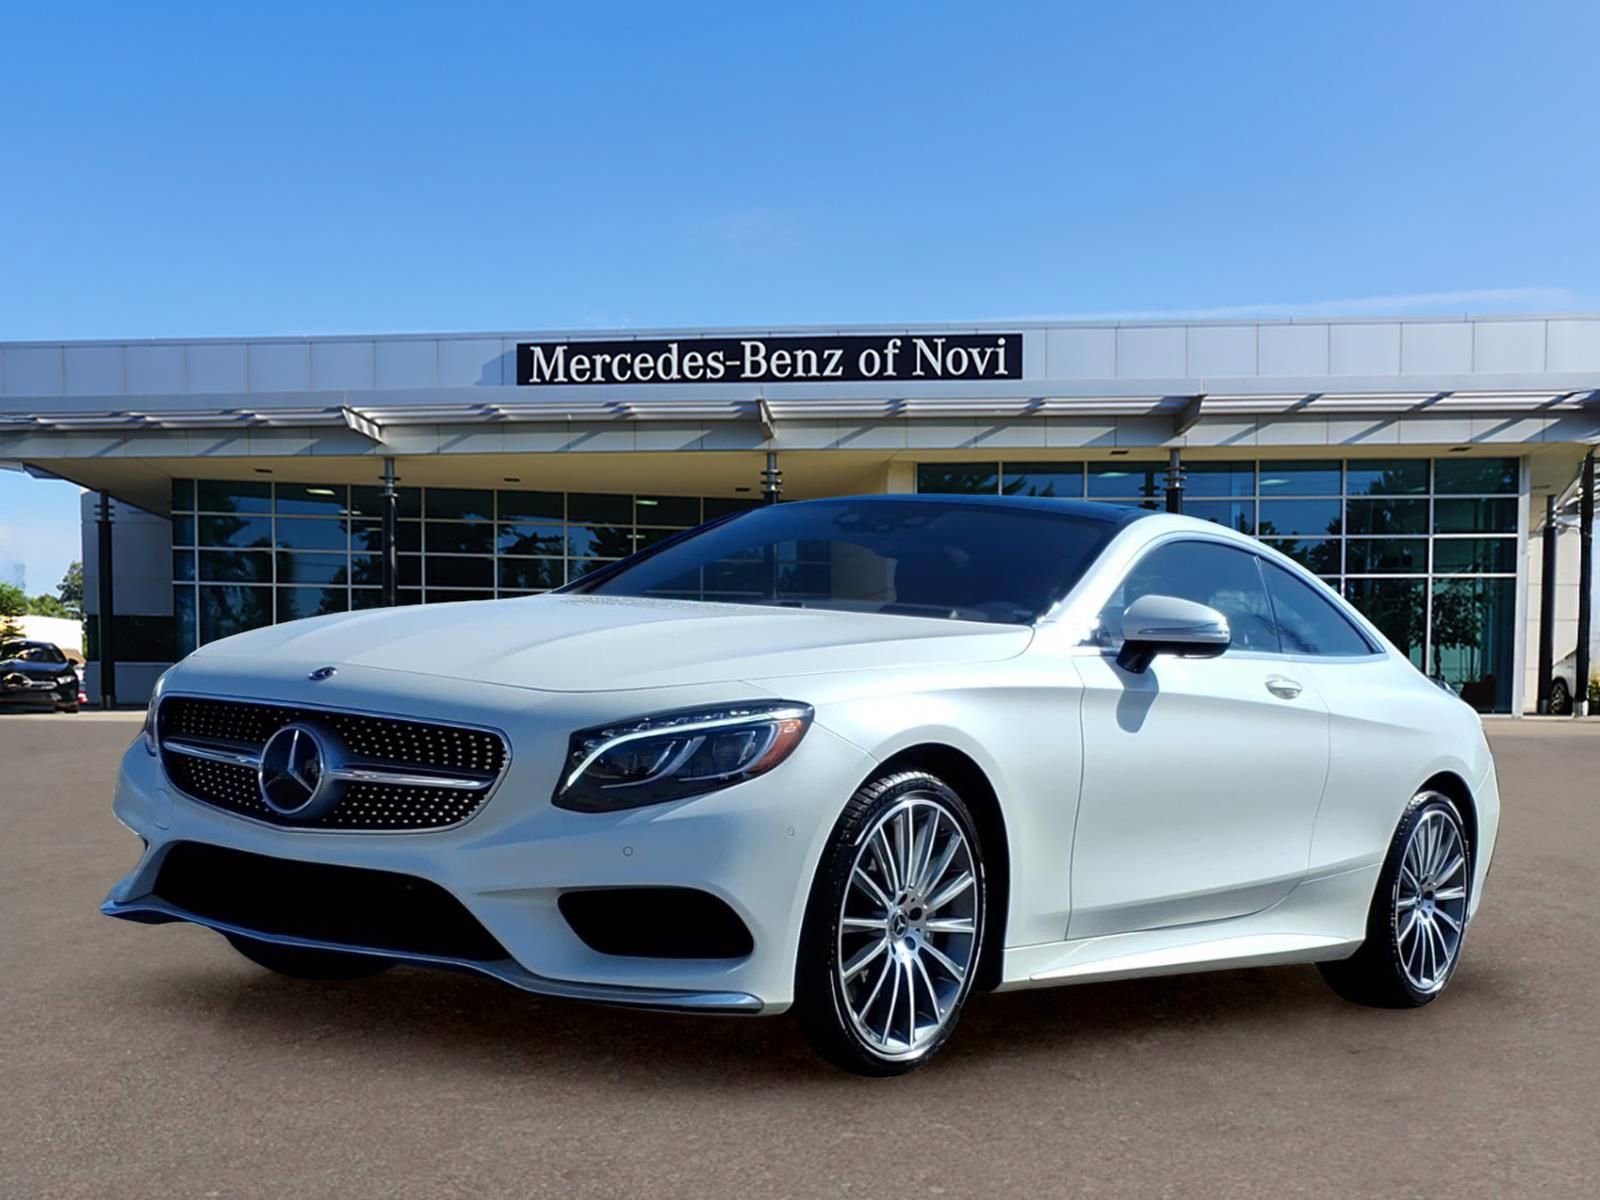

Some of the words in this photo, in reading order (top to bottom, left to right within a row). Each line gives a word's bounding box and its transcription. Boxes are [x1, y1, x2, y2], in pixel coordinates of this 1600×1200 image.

[529, 341, 844, 383] Mercedes-Benz
[858, 338, 901, 377] of
[912, 337, 1009, 376] Novi
